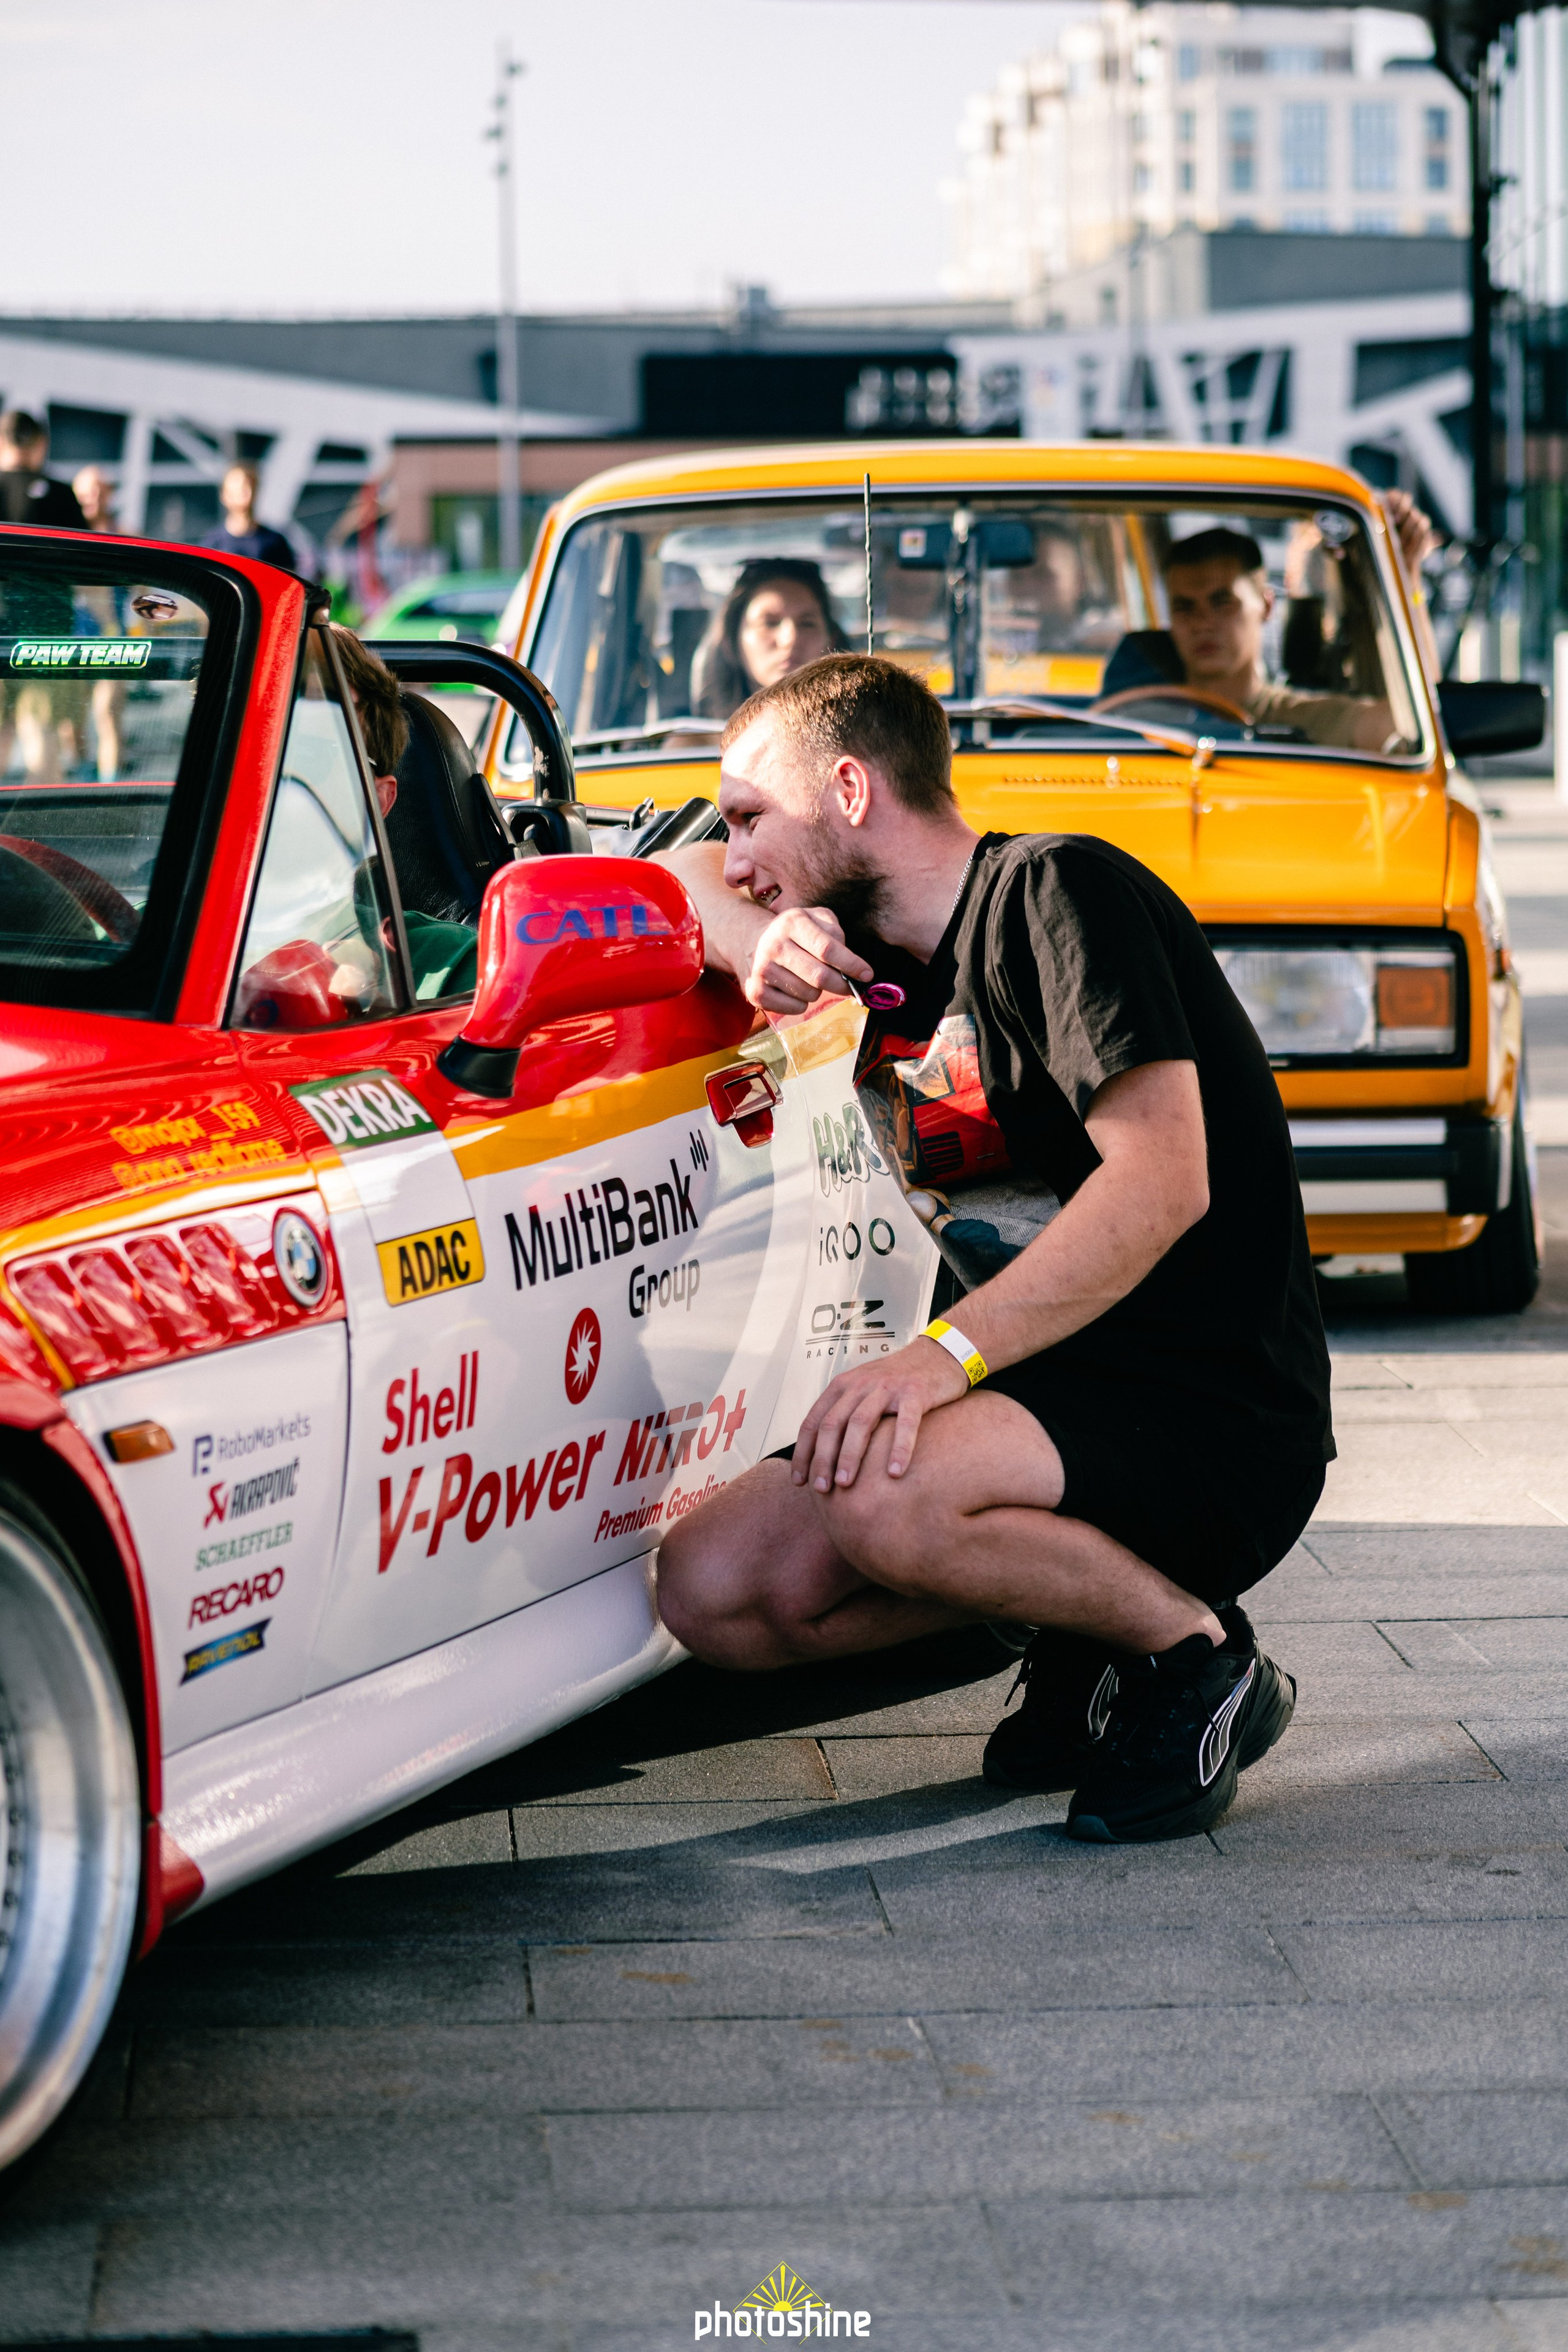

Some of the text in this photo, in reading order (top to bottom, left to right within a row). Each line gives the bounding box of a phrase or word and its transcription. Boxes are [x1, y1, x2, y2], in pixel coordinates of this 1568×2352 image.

[15, 644, 146, 666] PAW TEAM
[516, 905, 669, 945] CATL
[296, 1079, 431, 1144] DEKRA
[813, 1102, 891, 1197] H&R
[504, 1158, 698, 1291] MultiBank
[398, 1231, 470, 1297] ADAC
[629, 1259, 701, 1318] Group
[807, 1344, 889, 1359] RACING
[382, 1351, 479, 1454] Shell
[217, 1412, 311, 1462] RoboMarkets
[378, 1430, 606, 1574] V-Power
[594, 1497, 663, 1544] Premium
[195, 1521, 293, 1572] SCHAEFFLER
[188, 1566, 284, 1630] RECARO
